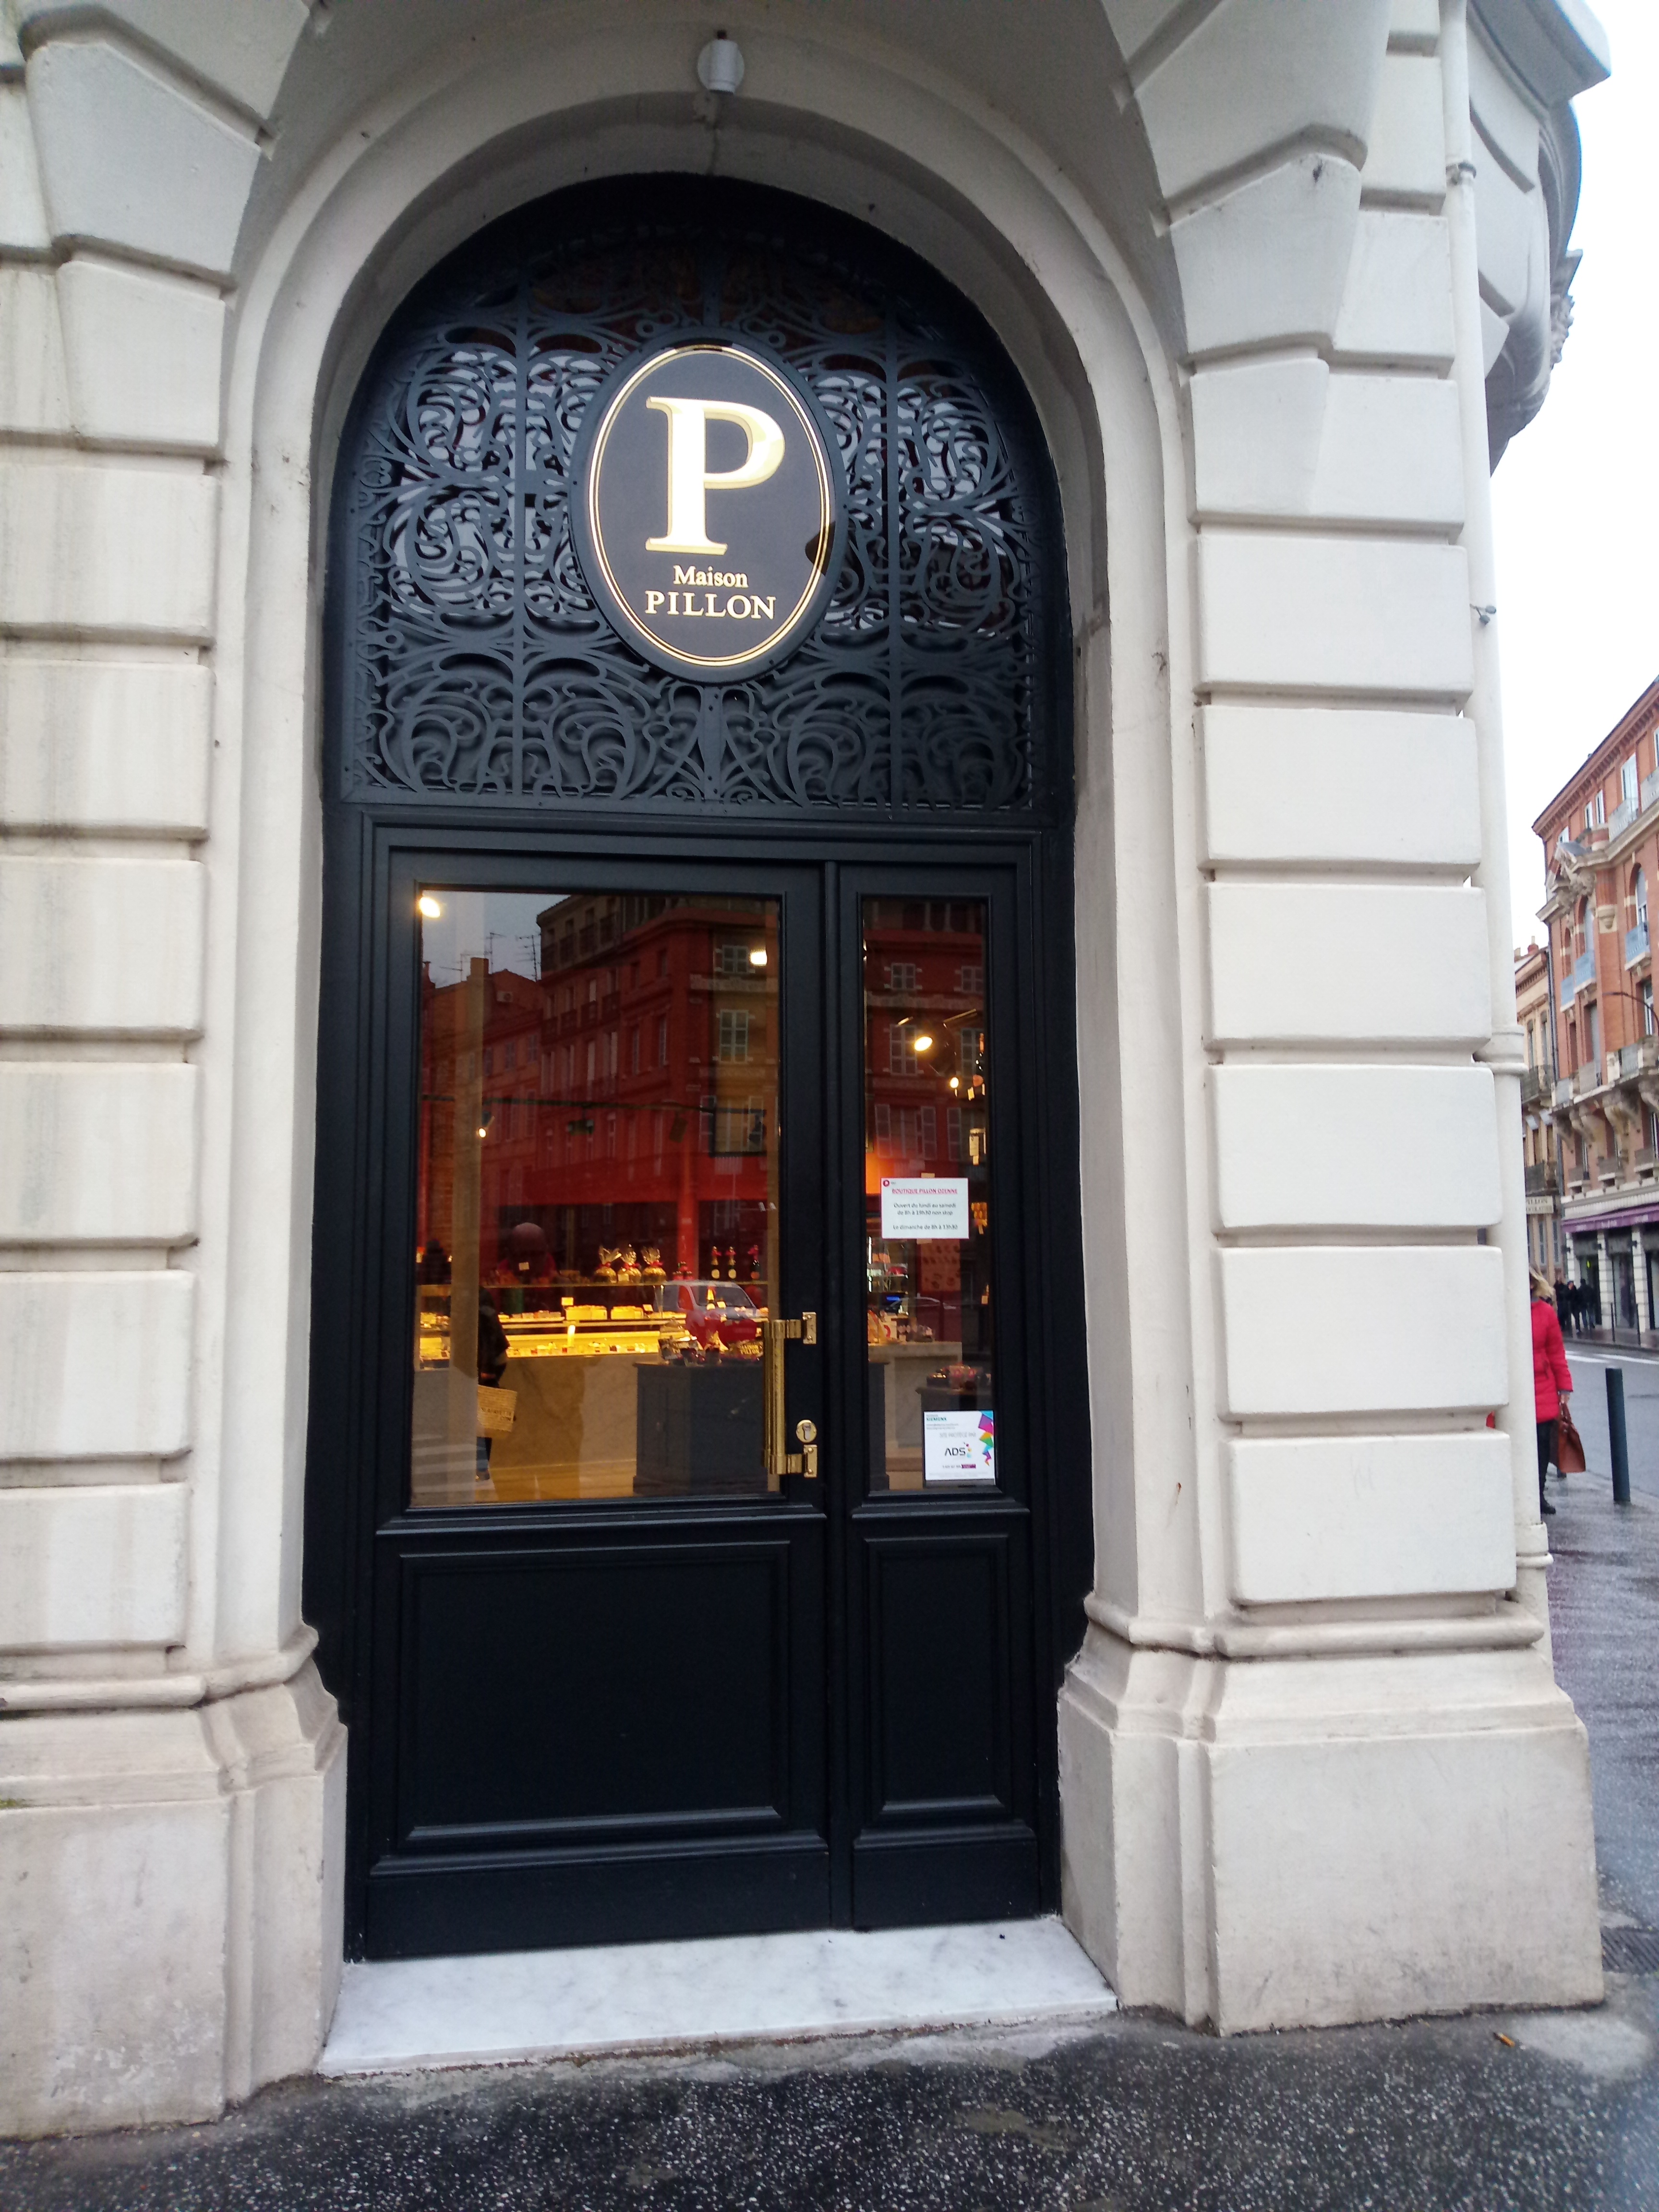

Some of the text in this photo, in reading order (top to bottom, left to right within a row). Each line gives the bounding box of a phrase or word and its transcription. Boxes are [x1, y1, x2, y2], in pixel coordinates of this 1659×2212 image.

[646, 396, 785, 555] P
[673, 565, 749, 589] Maison
[645, 590, 777, 620] PILLON
[945, 1447, 966, 1456] ADS
